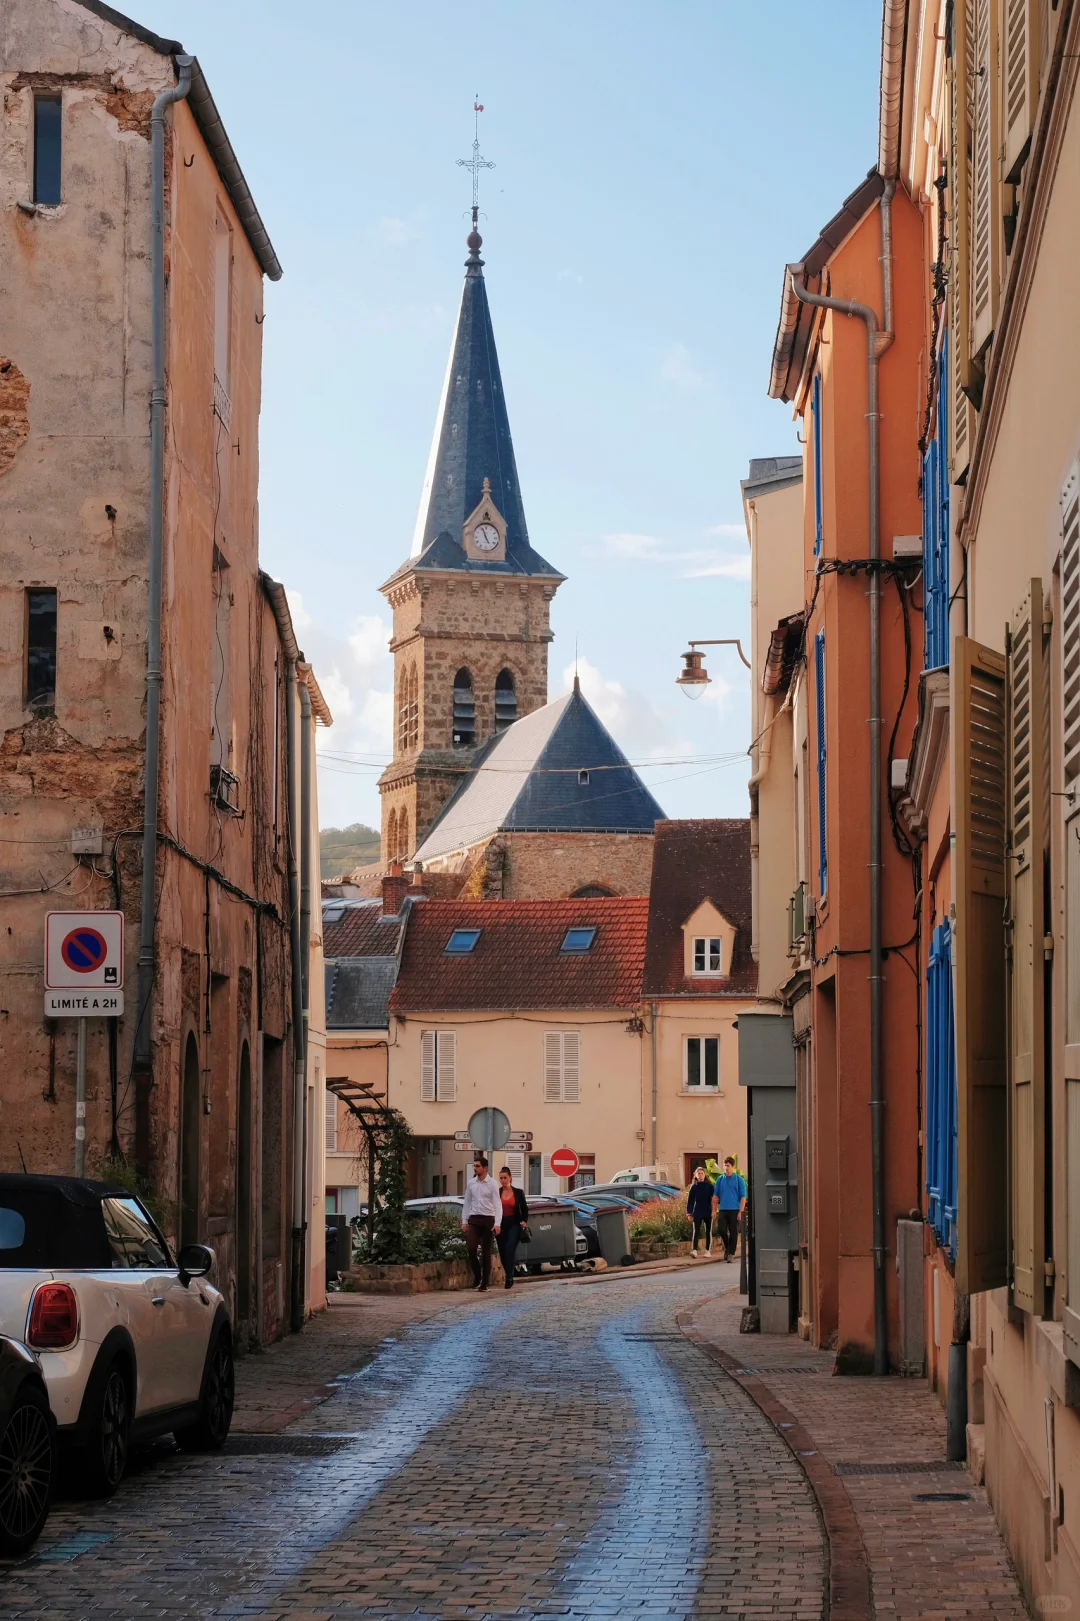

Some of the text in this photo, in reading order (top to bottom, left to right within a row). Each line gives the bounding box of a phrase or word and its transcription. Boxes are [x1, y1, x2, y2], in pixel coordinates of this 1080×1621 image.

[51, 997, 117, 1009] LIMITÉ A 2H
